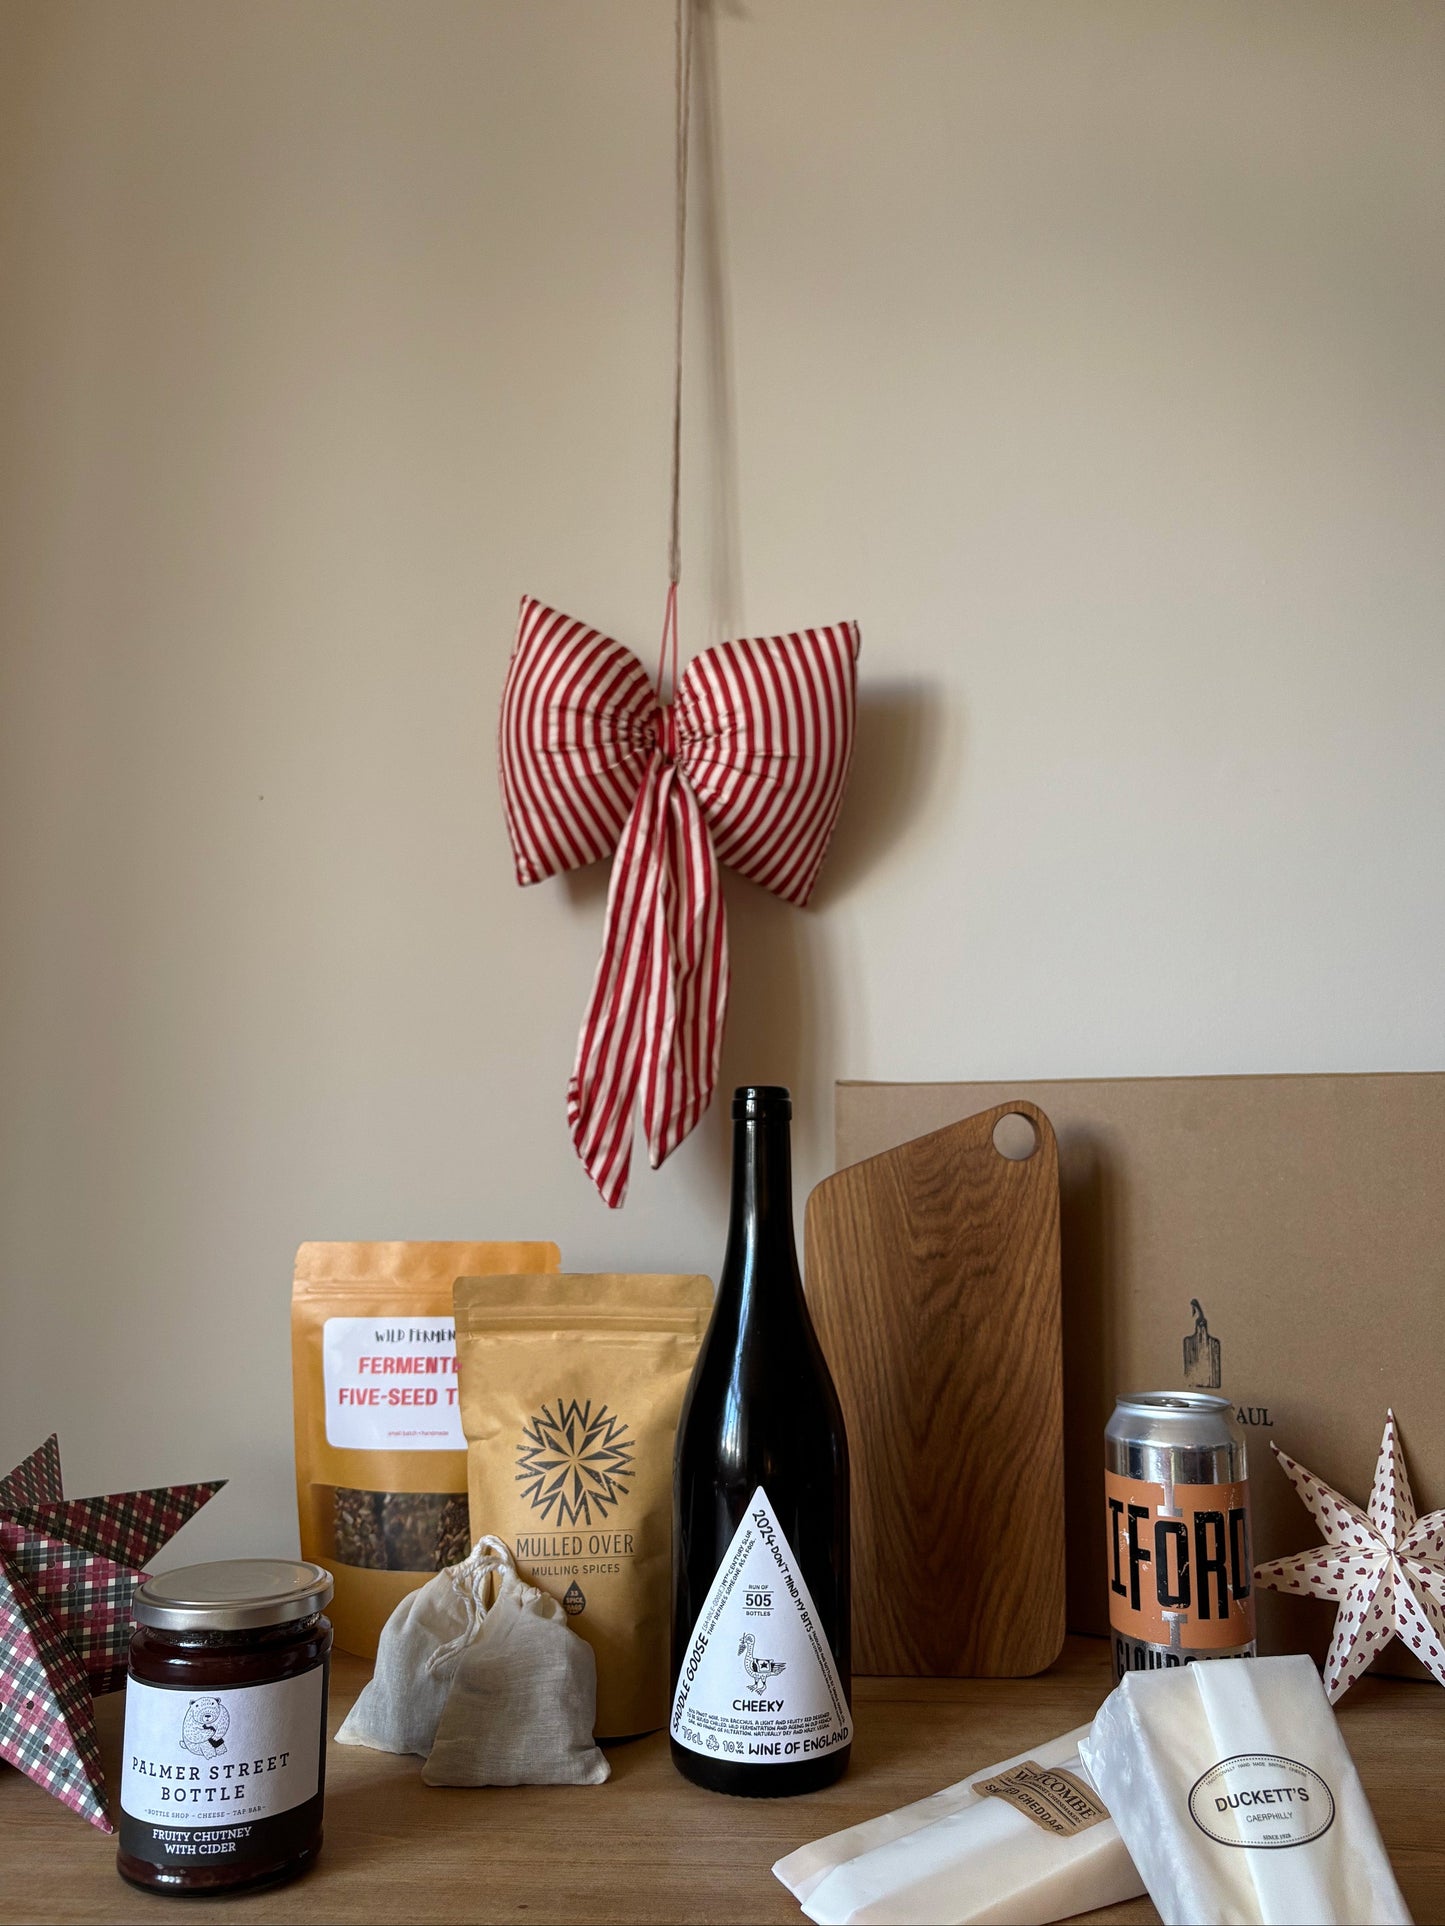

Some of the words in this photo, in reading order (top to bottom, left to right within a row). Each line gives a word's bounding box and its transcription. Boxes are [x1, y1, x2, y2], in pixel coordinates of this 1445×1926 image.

[375, 1329, 405, 1342] WILD
[338, 1388, 438, 1406] FIVE-SEED
[1231, 1406, 1274, 1427] AUL
[516, 1536, 582, 1557] MULLED
[589, 1534, 634, 1555] OVER
[728, 1545, 745, 1574] CENTURY
[742, 1530, 752, 1545] SLUR
[1108, 1496, 1251, 1620] IFORD
[531, 1565, 579, 1576] MULLING
[582, 1563, 620, 1575] SPICES
[752, 1510, 776, 1547] 2024
[771, 1545, 789, 1574] DON'T
[784, 1575, 799, 1598] MIND
[794, 1597, 805, 1611] MY
[800, 1611, 814, 1633] BITS
[707, 1620, 717, 1636] THAT
[713, 1596, 728, 1620] DEFINES
[725, 1568, 742, 1595] SOMEONE
[739, 1559, 746, 1569] AS
[745, 1538, 757, 1554] FOOL.
[745, 1594, 772, 1607] 505
[672, 1680, 690, 1733] SADDLE
[687, 1632, 709, 1681] GOOSE
[733, 1700, 784, 1712] CHEEKY
[813, 1712, 830, 1720] DESIGNED
[723, 1740, 735, 1753] 10
[749, 1742, 781, 1755] WINE
[784, 1742, 800, 1755] OF
[804, 1727, 849, 1752] ENGLAND
[132, 1756, 201, 1781] PALMER
[209, 1752, 290, 1780] STREET
[1206, 1766, 1236, 1786] TRADITIONALLY
[161, 1785, 245, 1802] BOTTLE
[1014, 1770, 1096, 1820] WTCOMBE
[1215, 1787, 1310, 1812] DUCKETT'S
[197, 1811, 225, 1819] CHEESE
[1018, 1792, 1064, 1831] CHEDDAR
[1246, 1811, 1293, 1823] CAERPHILLY
[152, 1828, 191, 1842] FRUITY
[193, 1826, 252, 1842] CHUTNEY
[164, 1843, 196, 1855] WITH
[198, 1842, 236, 1855] CIDER
